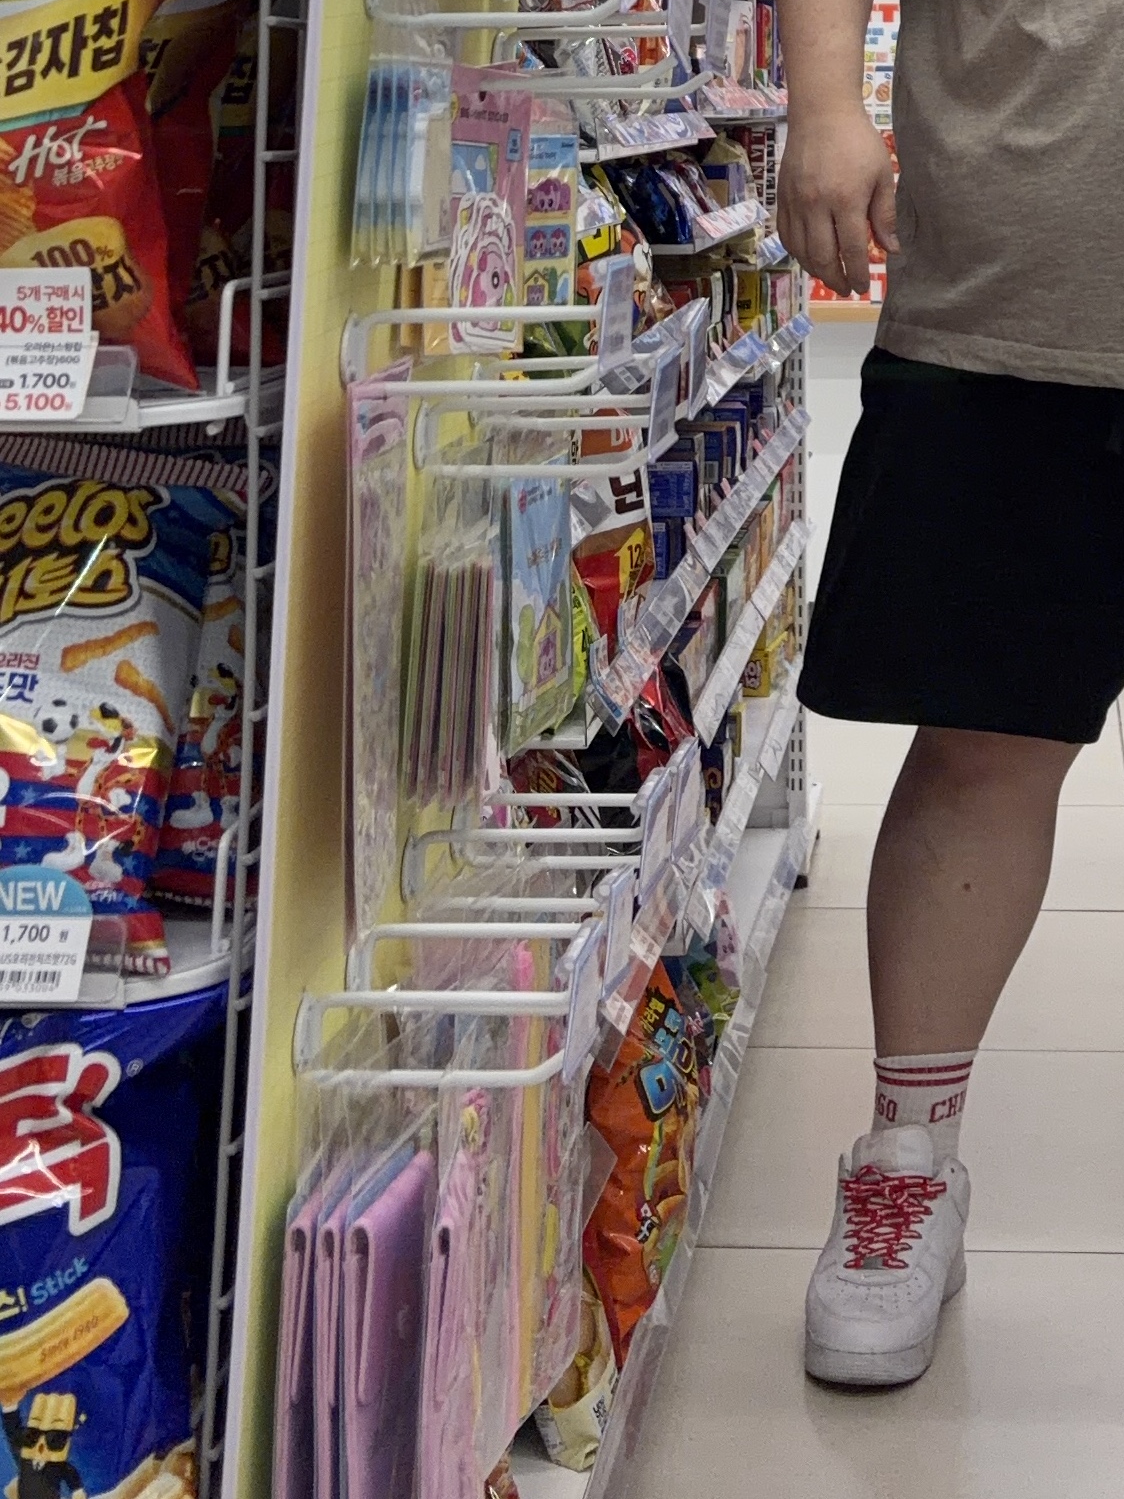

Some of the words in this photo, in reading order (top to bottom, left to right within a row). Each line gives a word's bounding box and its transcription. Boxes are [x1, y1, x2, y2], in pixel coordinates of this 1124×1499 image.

[9, 115, 107, 185] Hot
[17, 286, 41, 301] 5개
[44, 286, 69, 301] 구매
[71, 285, 85, 302] 시
[46, 305, 84, 333] 할인
[0, 881, 66, 912] NEW
[2, 925, 50, 943] 1,700
[31, 1255, 90, 1306] Stick
